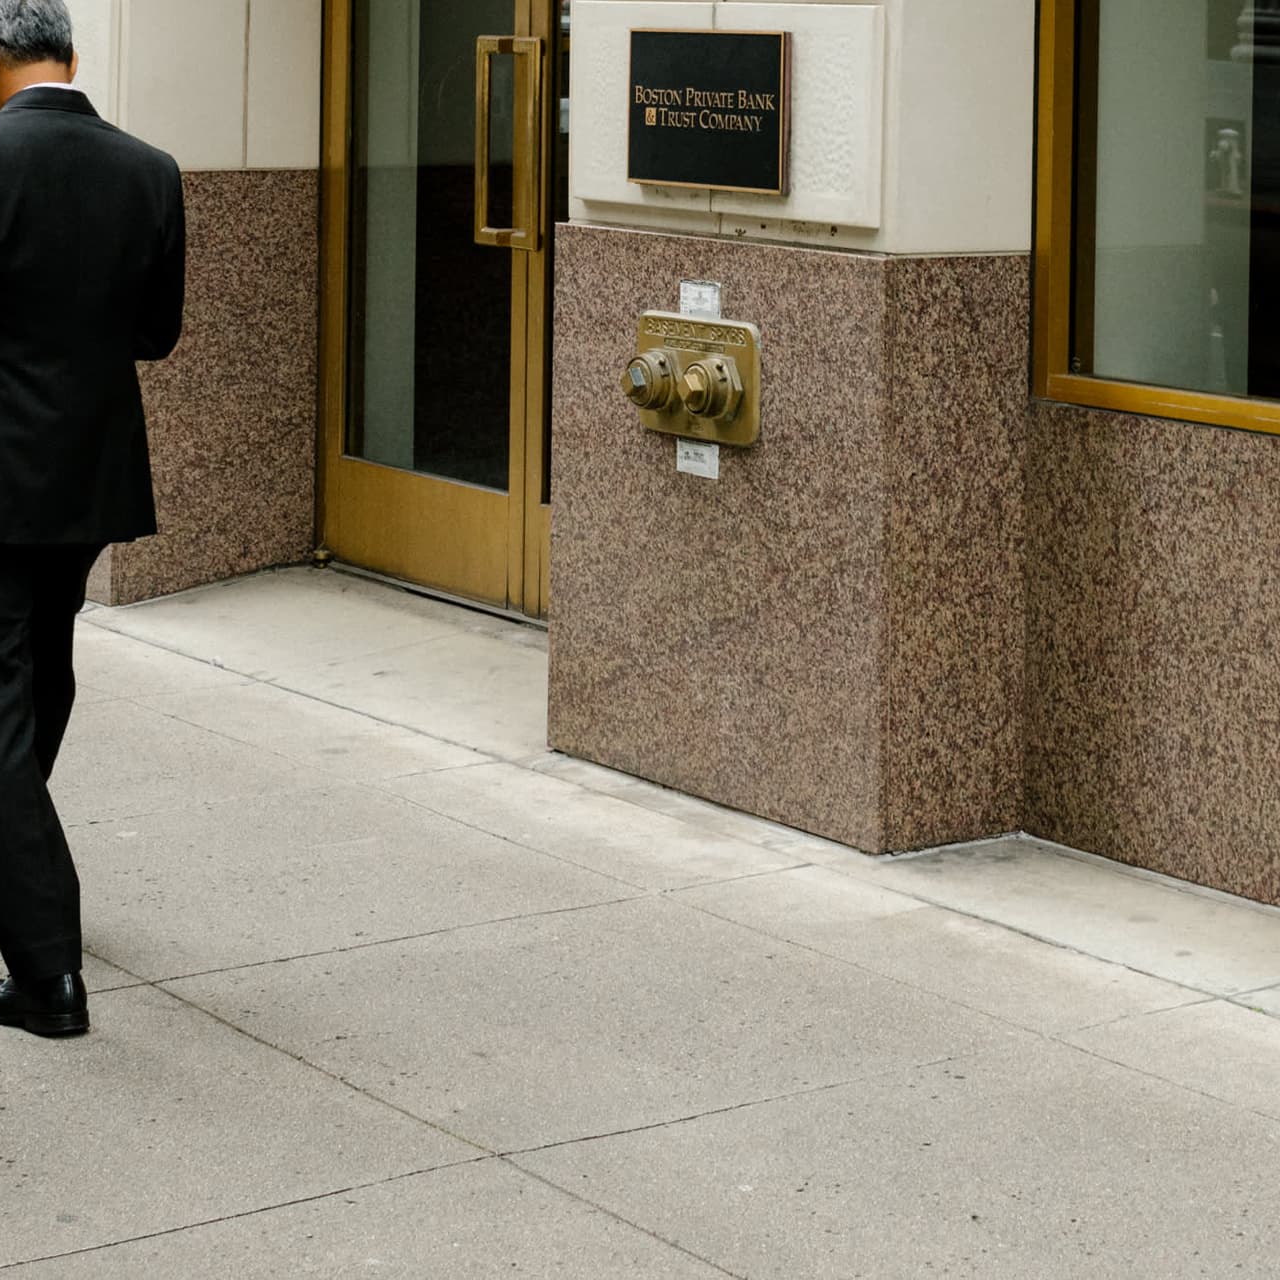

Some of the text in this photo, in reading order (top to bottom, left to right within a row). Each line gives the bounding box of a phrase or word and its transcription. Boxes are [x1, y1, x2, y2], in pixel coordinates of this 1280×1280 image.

[635, 85, 775, 110] BOSTON PRIVATE BANK
[645, 107, 763, 132] & TRUST COMPANY
